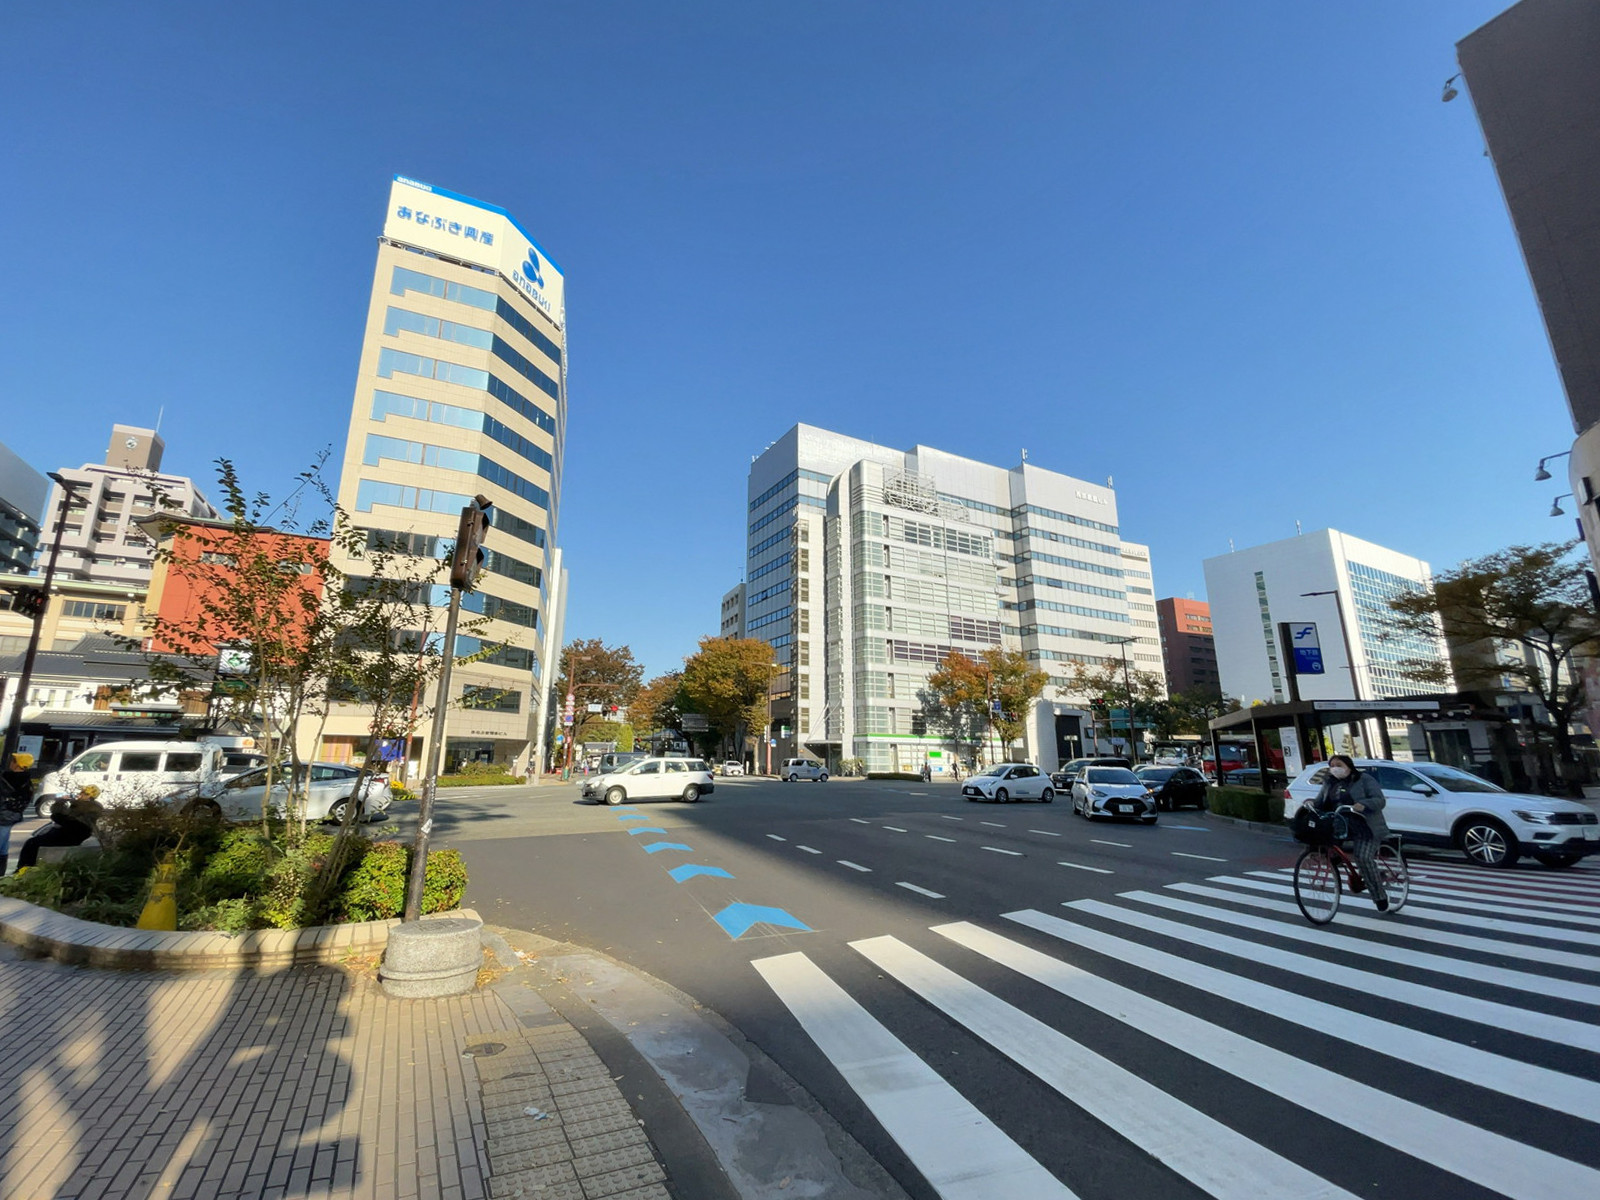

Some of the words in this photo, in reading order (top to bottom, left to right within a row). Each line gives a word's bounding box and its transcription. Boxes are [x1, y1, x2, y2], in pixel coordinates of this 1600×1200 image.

[397, 206, 494, 246] あなぶき興産
